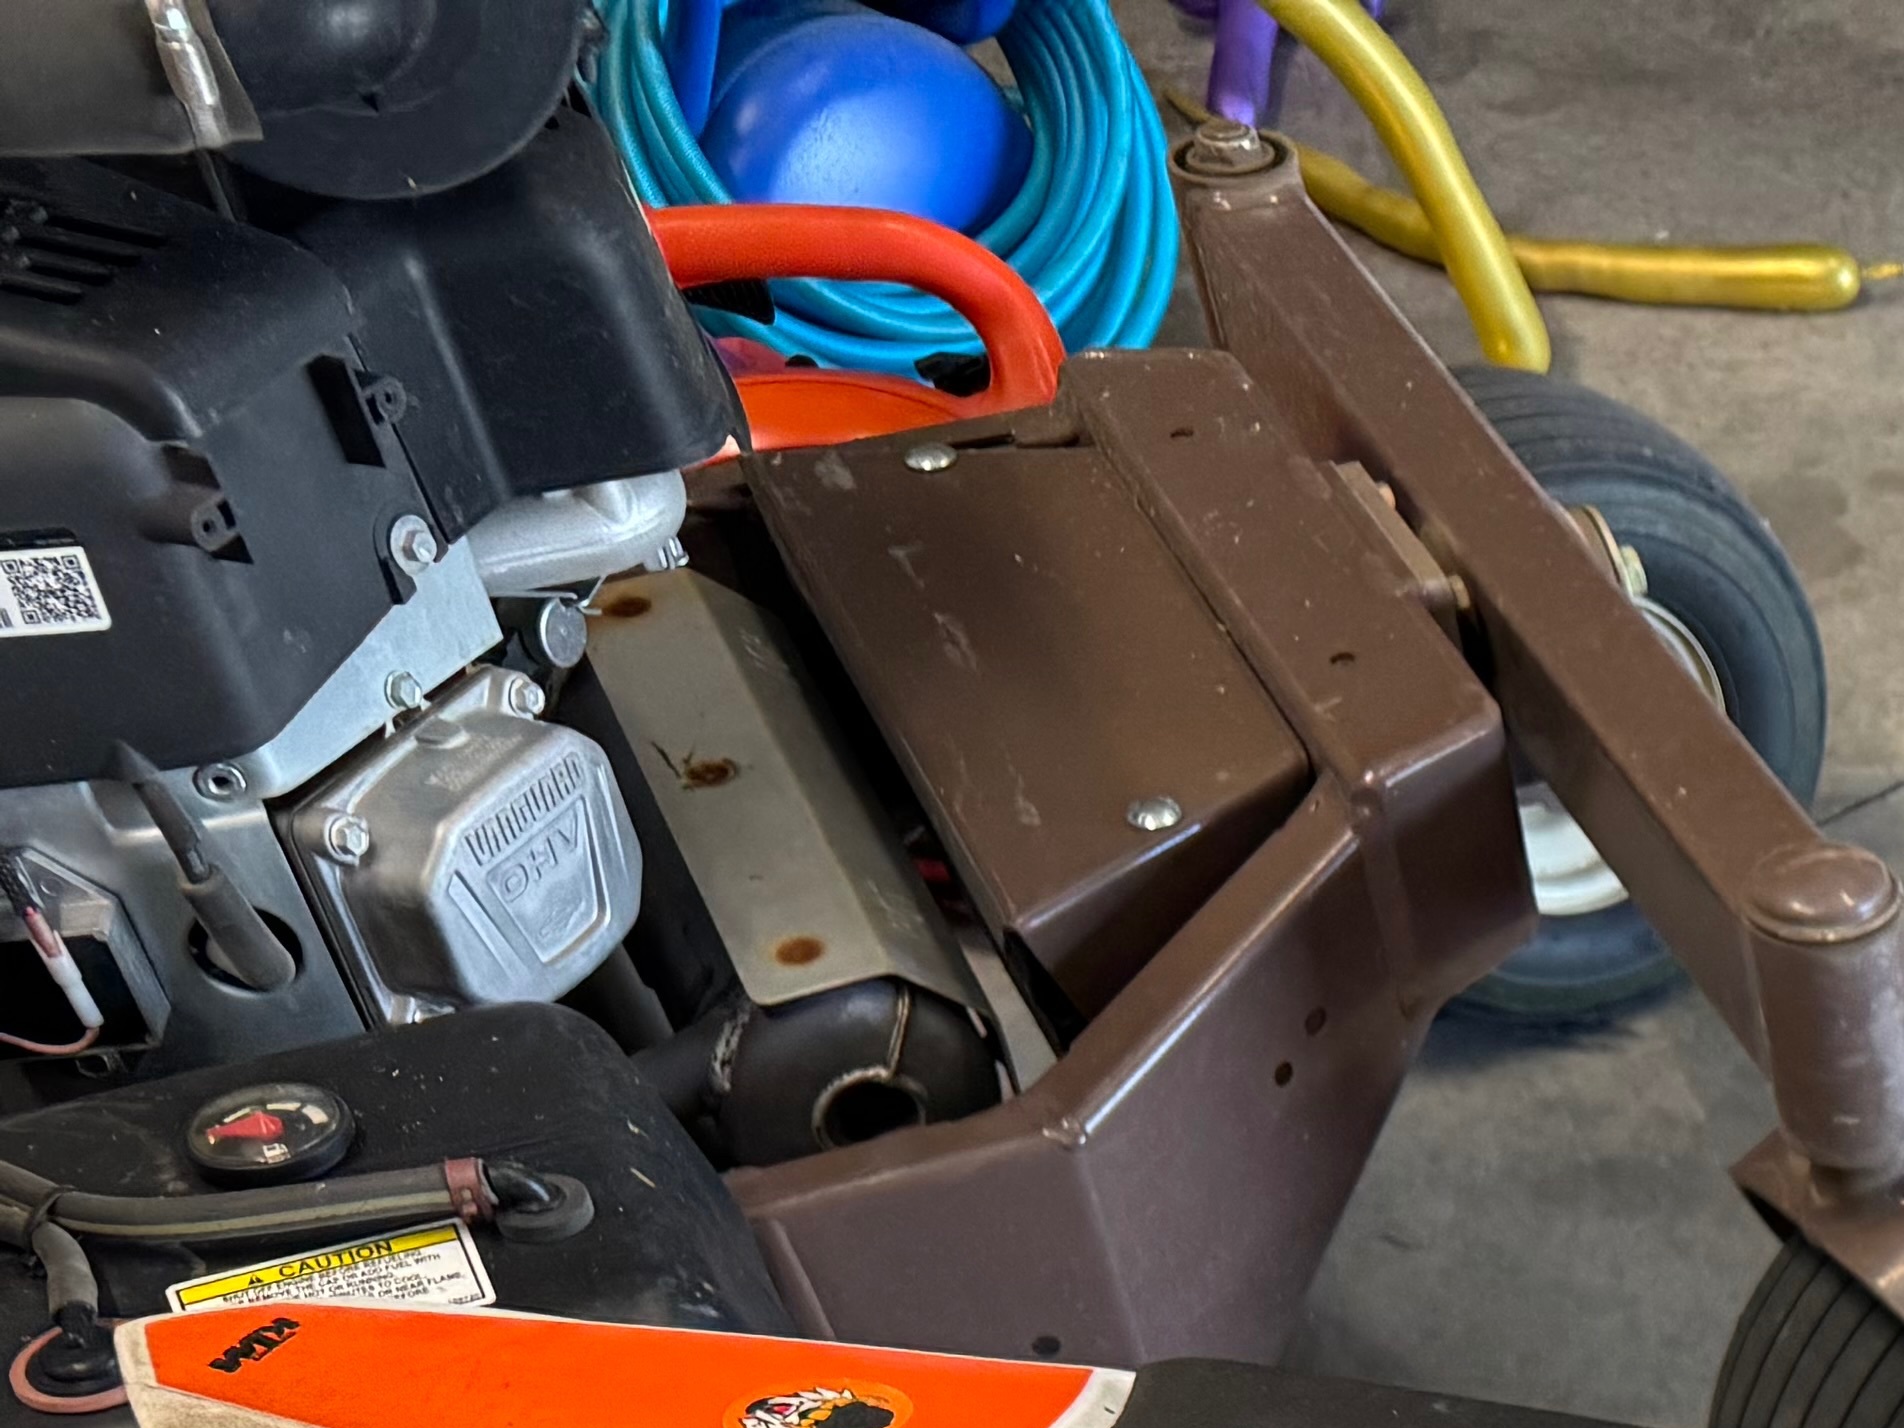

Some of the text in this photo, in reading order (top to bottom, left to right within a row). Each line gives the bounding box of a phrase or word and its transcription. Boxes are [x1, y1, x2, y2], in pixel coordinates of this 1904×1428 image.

[502, 807, 578, 902] OHV
[279, 1240, 393, 1278] CAUTION
[385, 1259, 410, 1271] FUEL
[414, 1252, 440, 1265] WITH
[208, 1317, 301, 1373] KTM
